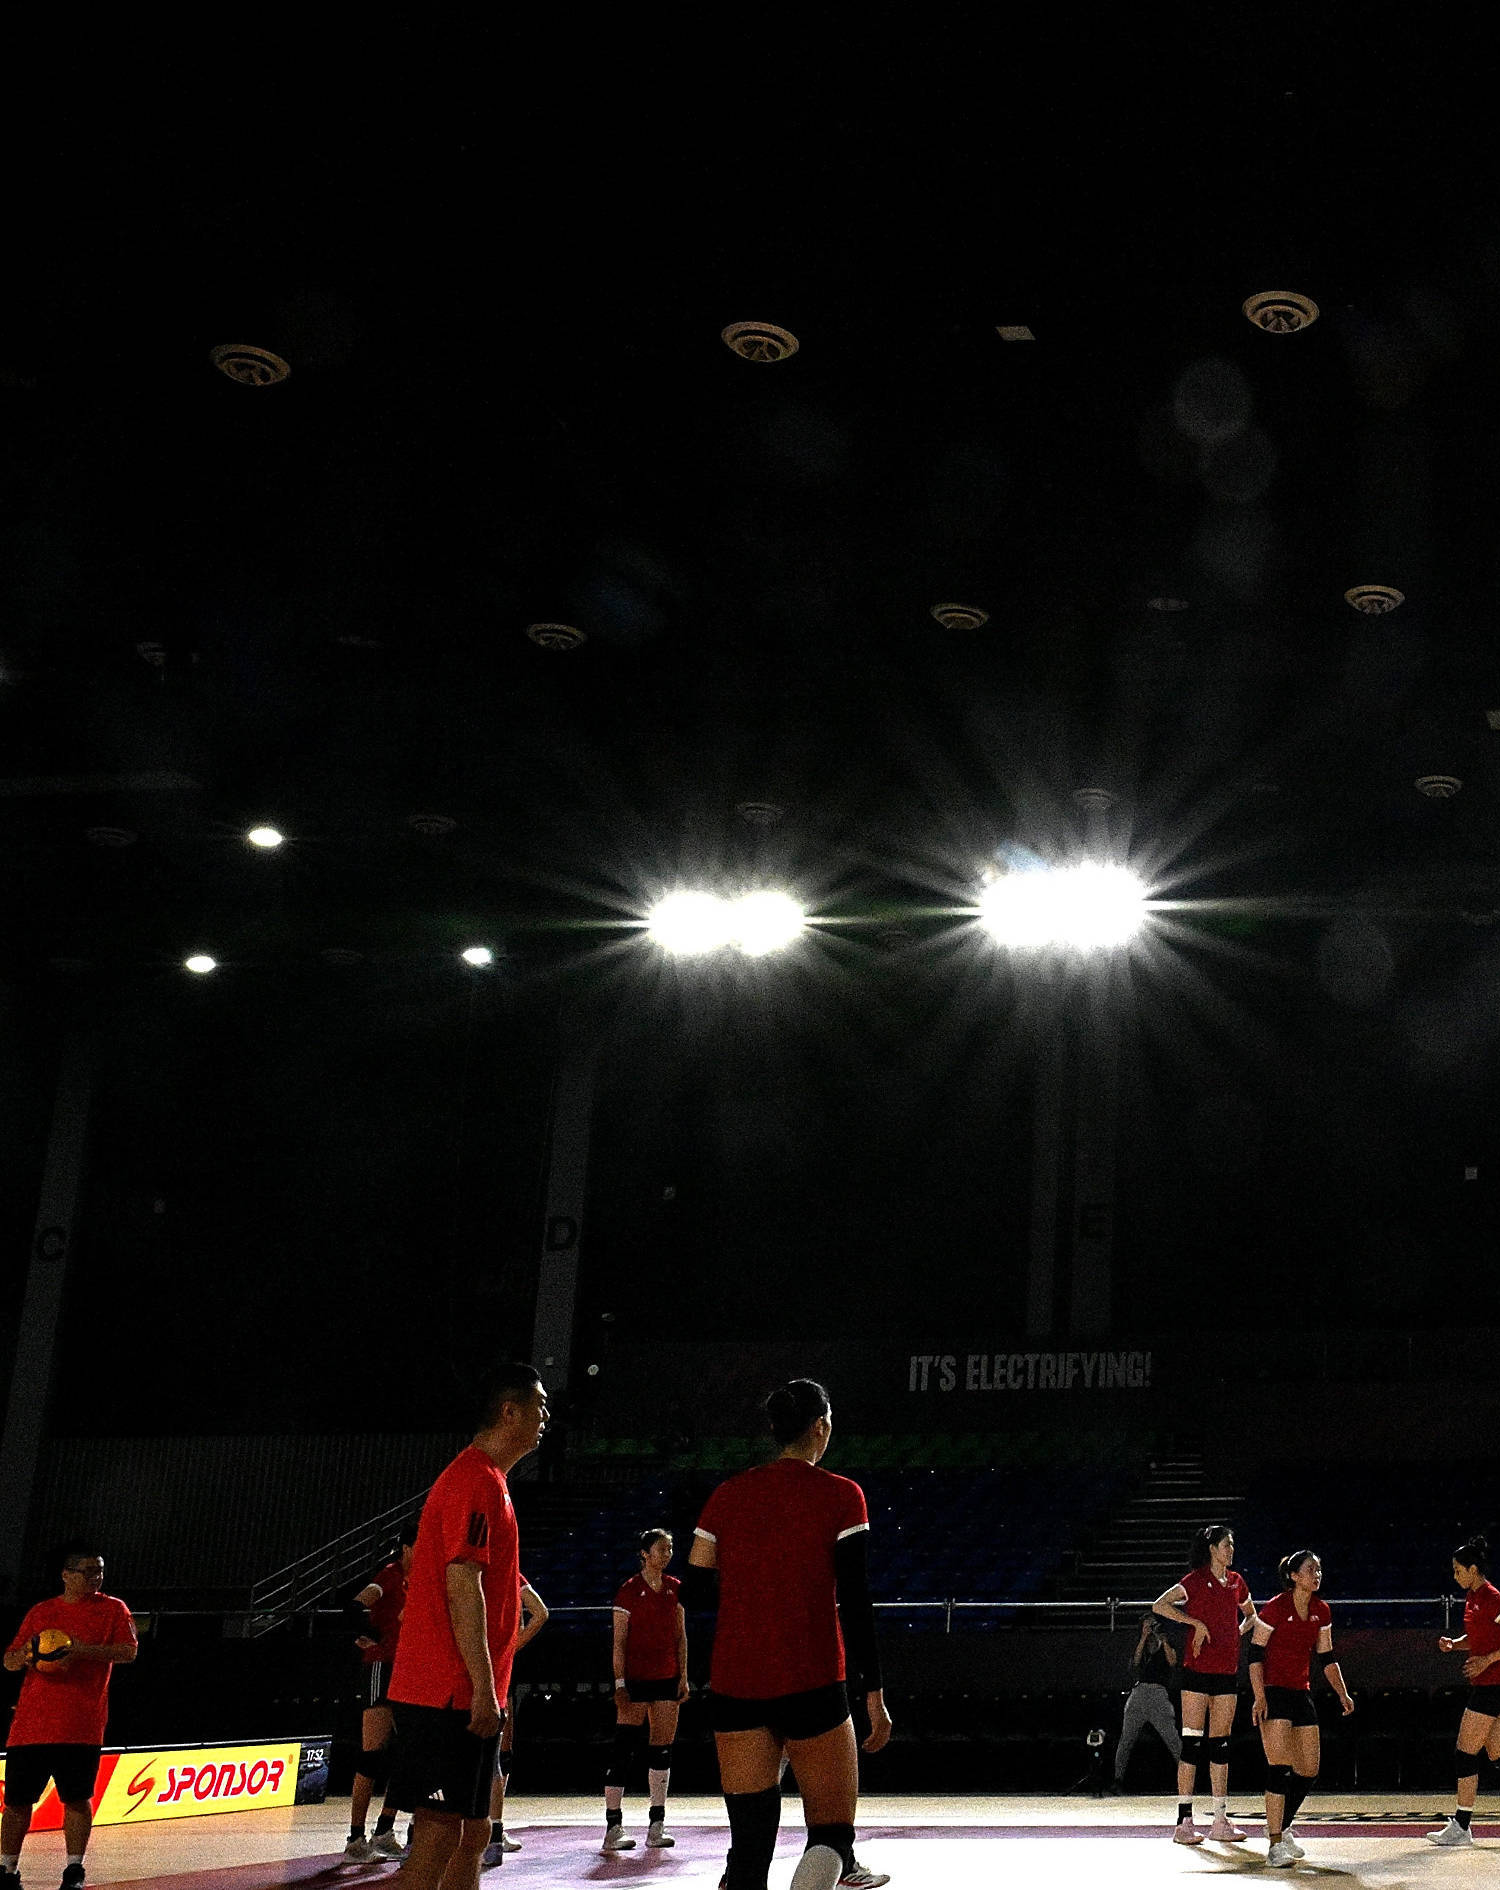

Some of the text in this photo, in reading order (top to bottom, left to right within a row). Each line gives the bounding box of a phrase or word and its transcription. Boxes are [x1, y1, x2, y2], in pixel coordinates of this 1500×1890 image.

[36, 1226, 66, 1262] C
[547, 1215, 577, 1252] D
[909, 1351, 1152, 1391] IT'S ELECTRIFYING!
[157, 1760, 285, 1803] SPONSOR
